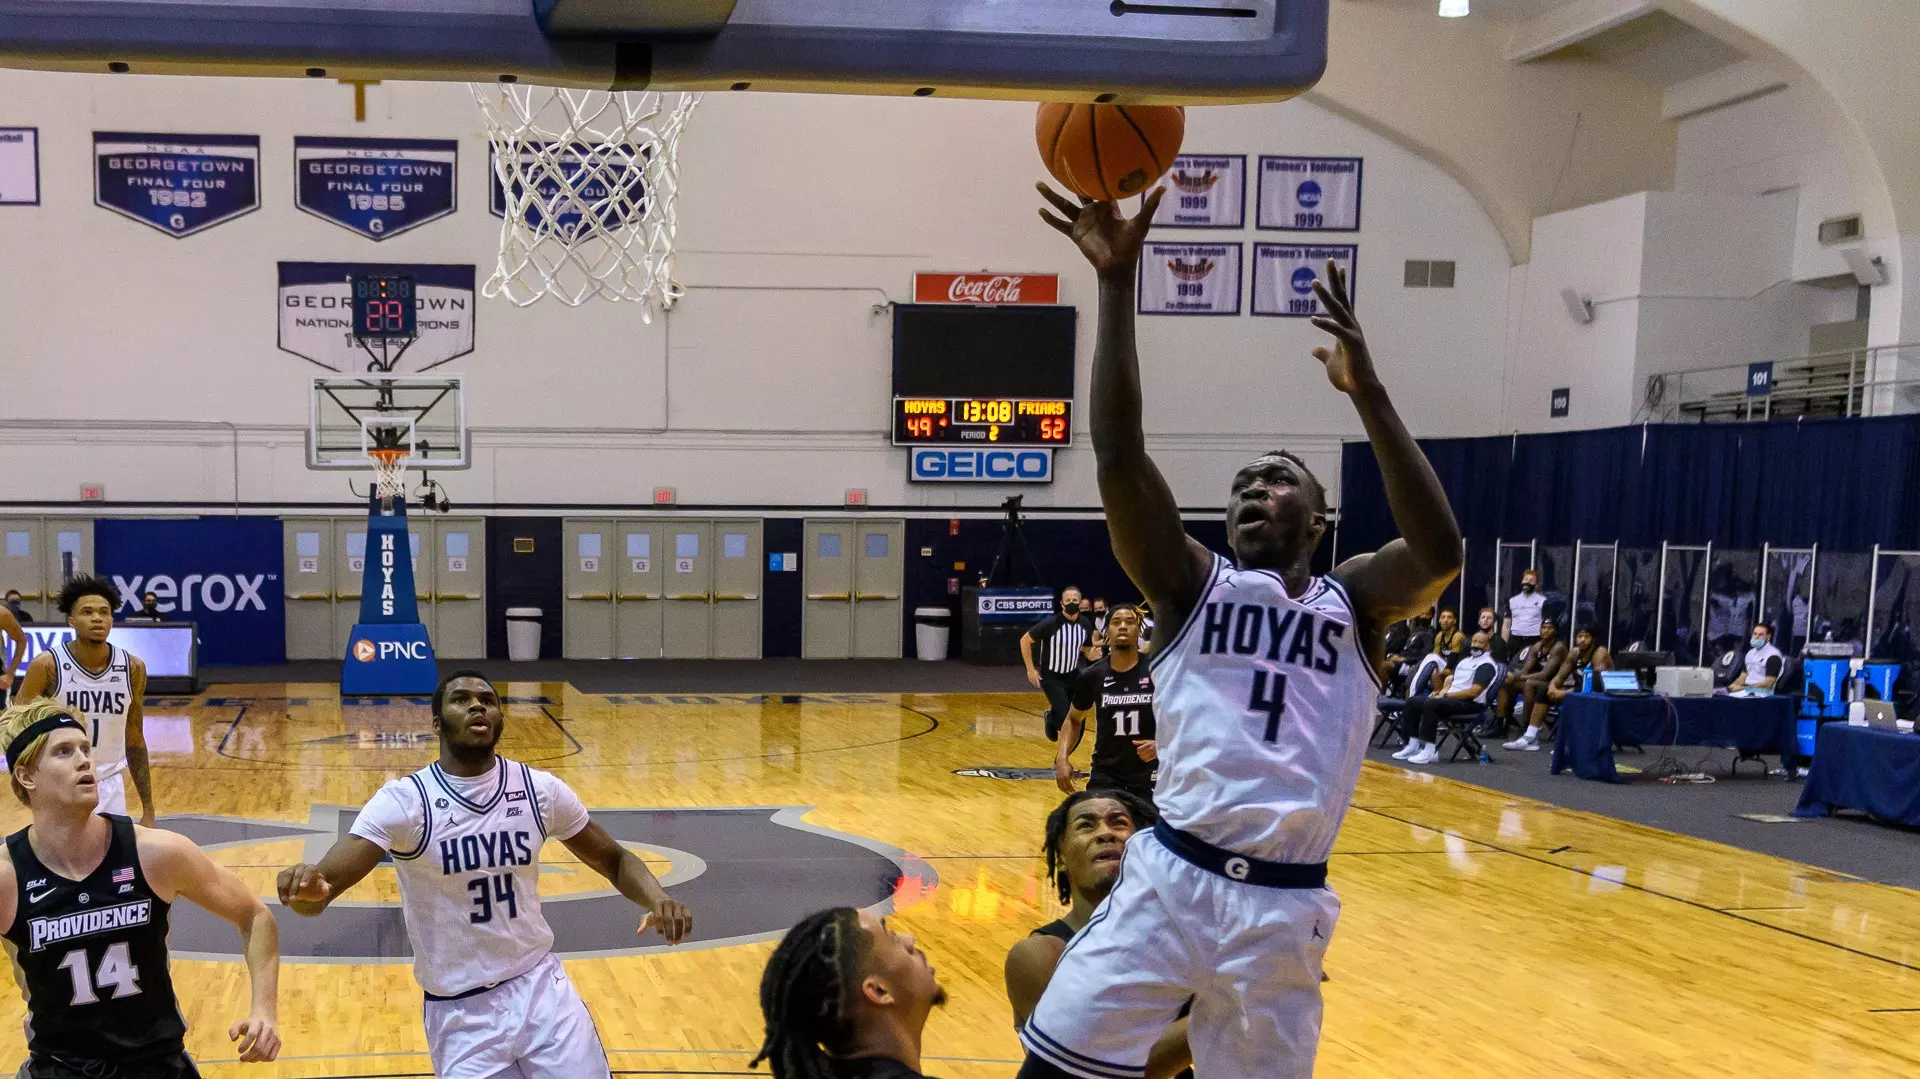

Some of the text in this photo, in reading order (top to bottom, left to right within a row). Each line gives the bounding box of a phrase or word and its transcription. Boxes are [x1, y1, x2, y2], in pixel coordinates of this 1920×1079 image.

[108, 158, 244, 172] GEORGETOWN
[309, 163, 442, 177] GEORGETOWN
[127, 177, 226, 189] FINAL FOUR
[327, 182, 424, 193] FINAL FOUR
[148, 190, 207, 208] 1982
[348, 194, 405, 211] 1985
[1180, 196, 1208, 209] 1999
[1294, 213, 1323, 227] 1999
[1177, 283, 1203, 297] 1998
[1289, 299, 1317, 313] 1998
[366, 301, 403, 331] 29
[1753, 371, 1768, 386] 101
[904, 400, 946, 414] HOYAS
[963, 401, 1011, 422] 13:08
[1018, 402, 1065, 415] FRIARS
[907, 417, 932, 436] 49
[960, 425, 999, 441] PERIOD 2
[1040, 418, 1065, 439] 52
[915, 451, 1048, 478] GEICO
[381, 534, 395, 616] HOYAS
[112, 574, 266, 613] xerox
[996, 600, 1053, 610] CBS SPORTS
[1200, 602, 1345, 676] HOYAS
[378, 641, 427, 660] PNC
[66, 690, 125, 715] HOYAS
[1101, 694, 1152, 708] PROVIDENCE
[1247, 669, 1288, 742] 4
[1111, 710, 1140, 736] 11
[440, 831, 532, 875] HOYAS
[1224, 857, 1250, 880] G
[468, 873, 518, 923] 34
[29, 900, 150, 951] PROVIDENCE
[57, 942, 142, 1005] 14
